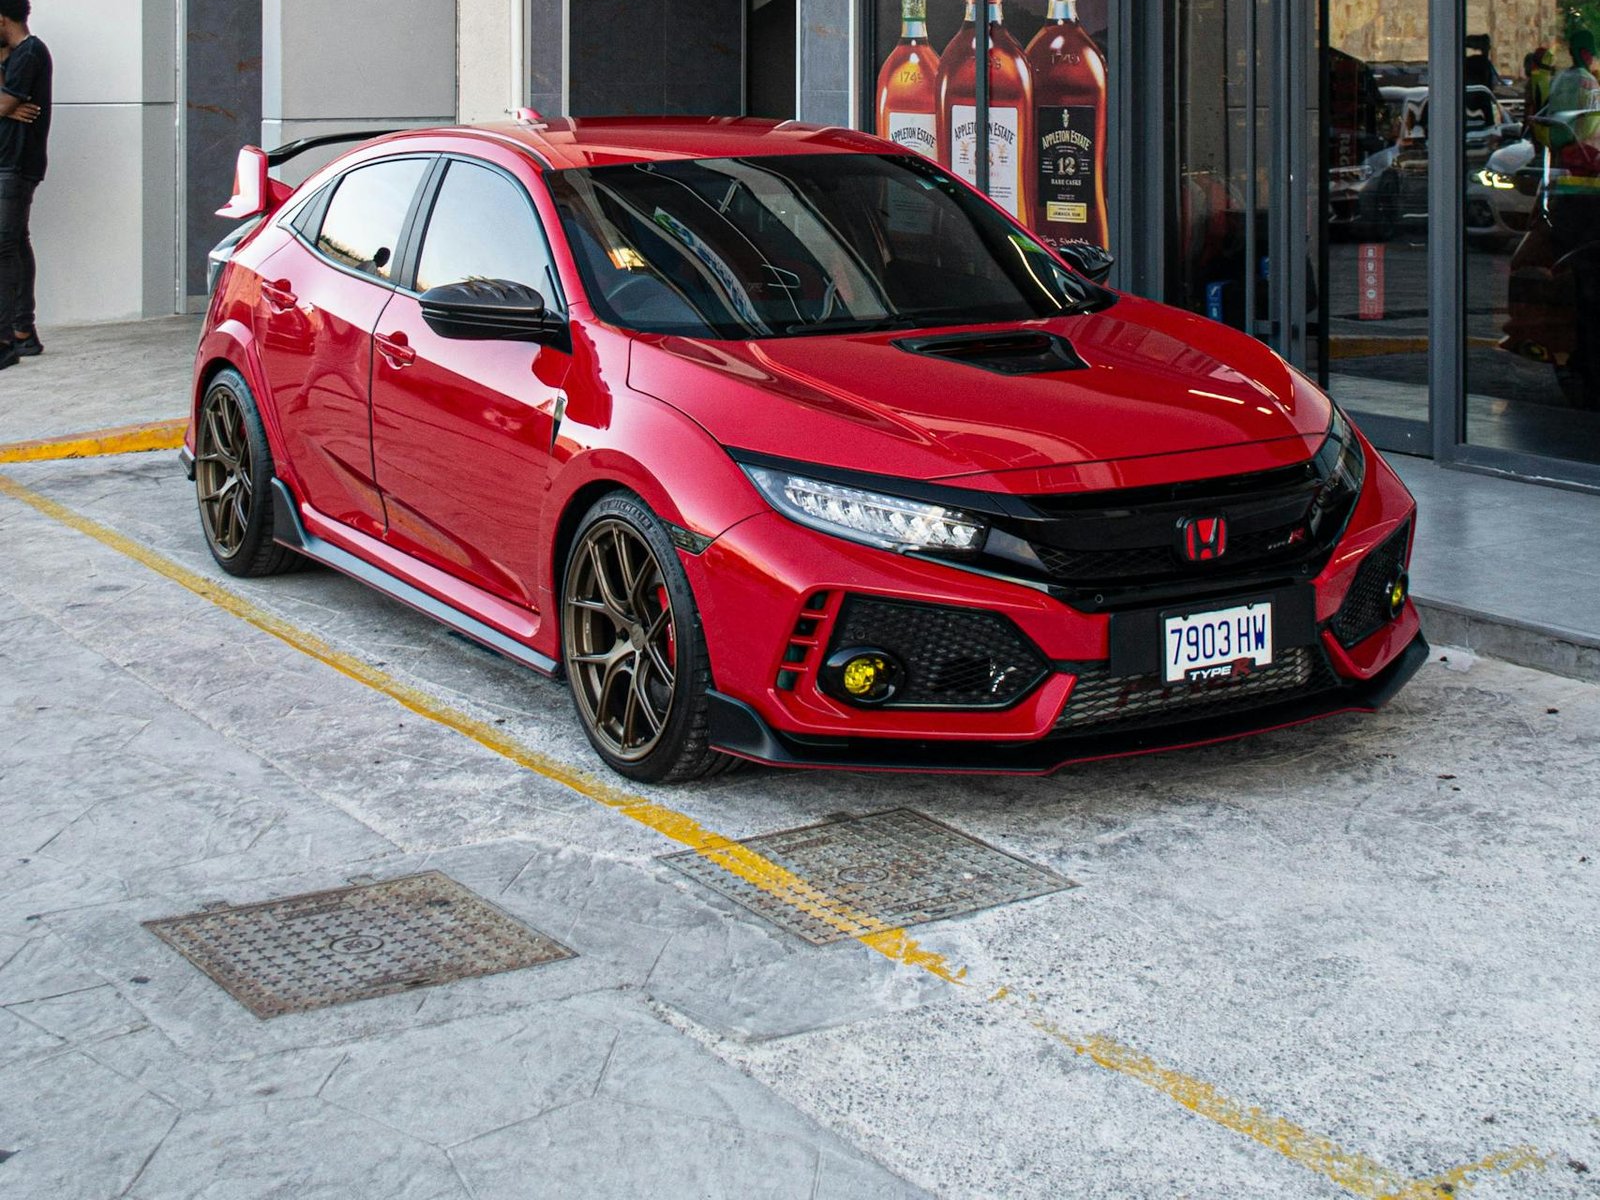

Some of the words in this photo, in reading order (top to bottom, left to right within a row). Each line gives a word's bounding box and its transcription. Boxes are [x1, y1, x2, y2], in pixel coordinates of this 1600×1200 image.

[994, 122, 1016, 145] ESTATE
[1042, 130, 1070, 151] APPLETON
[1071, 130, 1093, 152] ESTATE
[1056, 156, 1077, 176] 12
[1170, 620, 1231, 665] 7903
[1237, 613, 1266, 654] HW
[1190, 664, 1232, 681] TYPE
